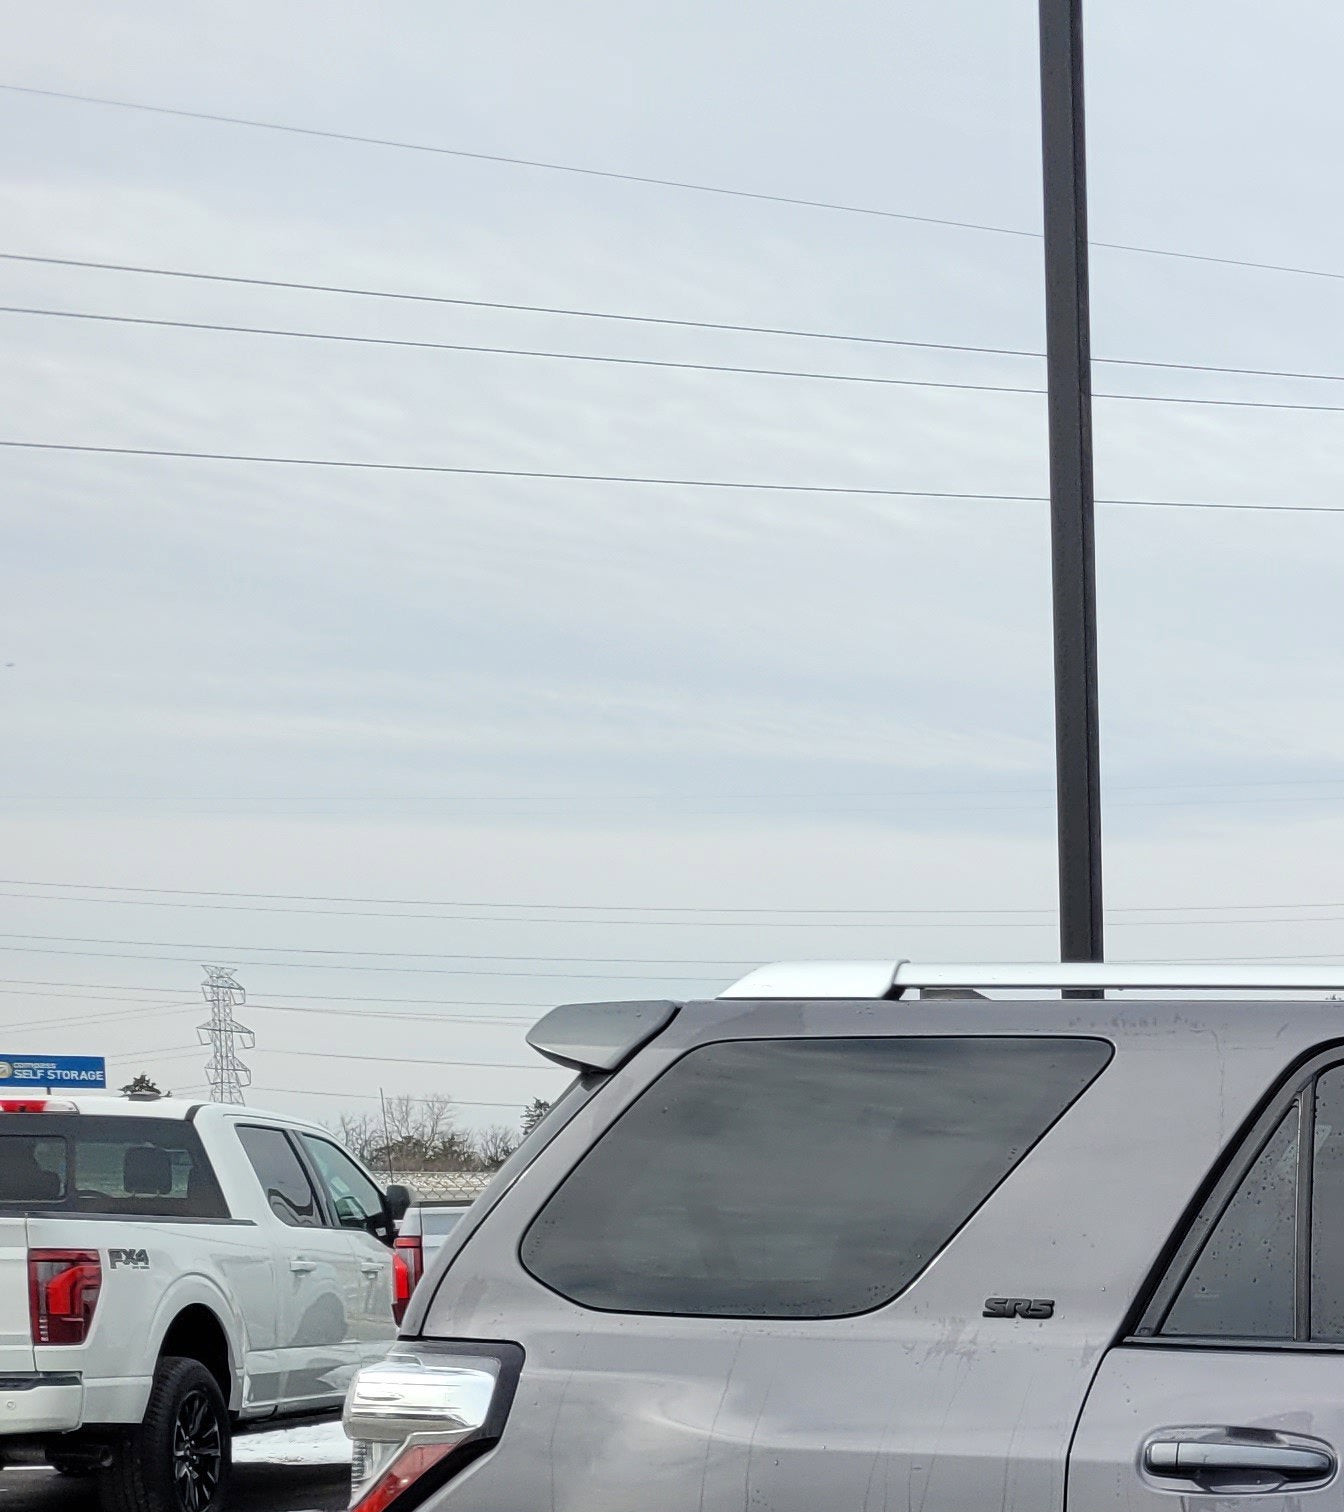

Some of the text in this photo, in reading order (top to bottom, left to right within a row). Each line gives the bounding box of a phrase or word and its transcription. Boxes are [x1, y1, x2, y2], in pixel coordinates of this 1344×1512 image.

[14, 1069, 104, 1080] SELF STORAGE
[107, 1248, 150, 1269] FX4
[983, 1298, 1055, 1319] SR5
